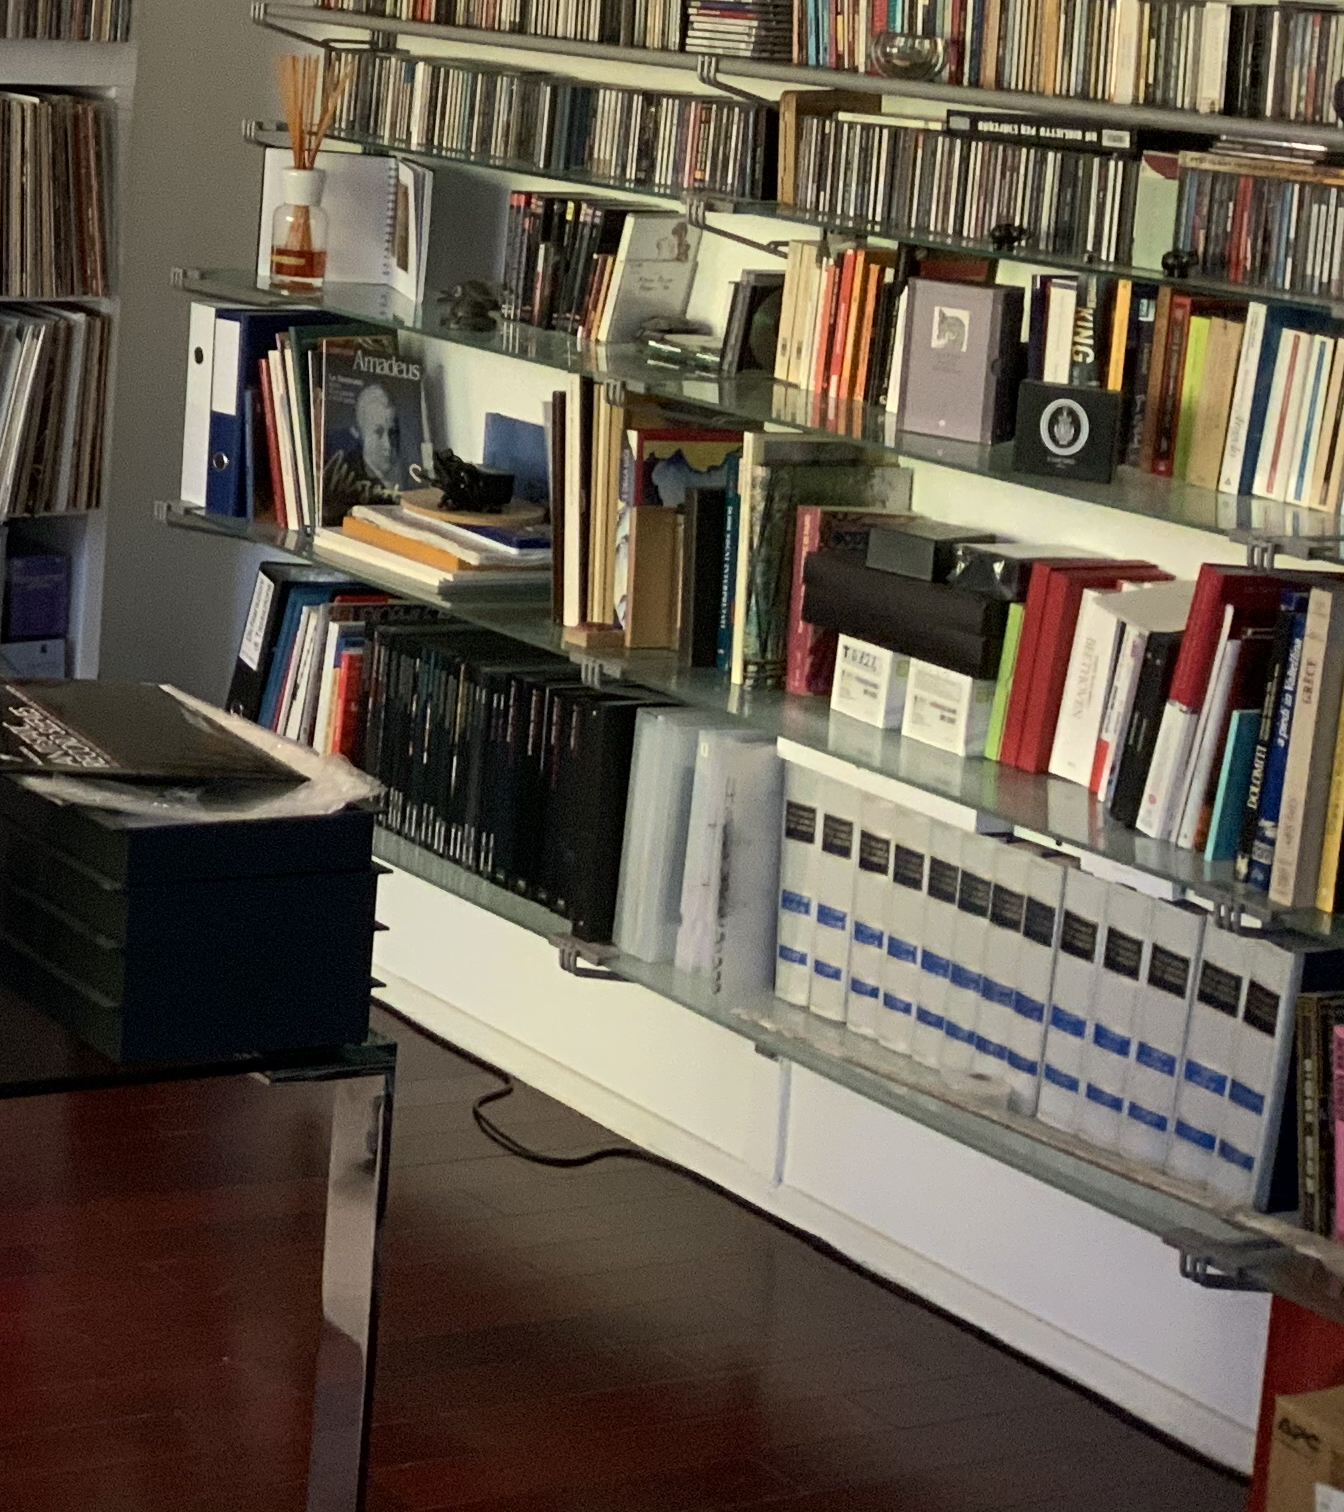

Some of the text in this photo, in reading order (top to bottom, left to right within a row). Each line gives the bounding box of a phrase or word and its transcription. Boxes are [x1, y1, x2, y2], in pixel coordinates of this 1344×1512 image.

[1020, 124, 1036, 136] PER
[1040, 127, 1083, 140] BIGLIETTO
[1072, 308, 1094, 363] KING
[353, 350, 421, 380] Amadeus
[1072, 638, 1096, 720] BEETHOVEN
[1247, 745, 1267, 809] DOLOMITI
